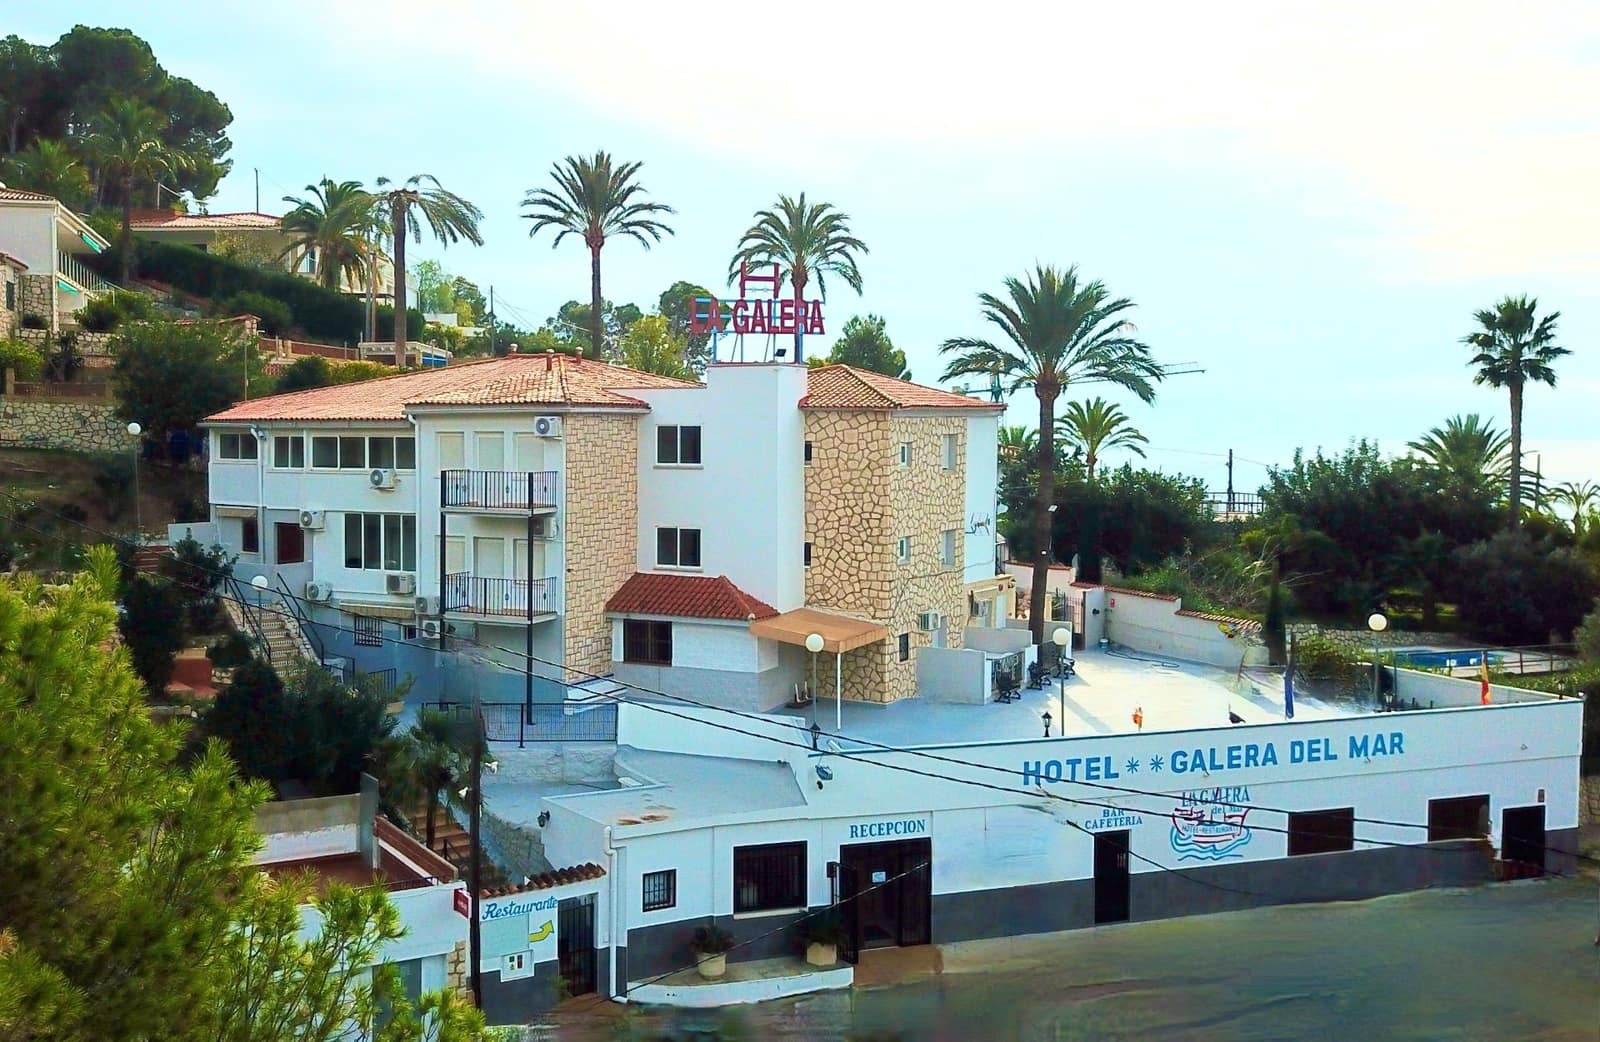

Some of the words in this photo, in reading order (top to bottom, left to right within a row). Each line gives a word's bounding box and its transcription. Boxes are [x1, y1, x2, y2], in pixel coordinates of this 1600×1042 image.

[740, 261, 779, 298] H
[690, 296, 724, 334] LA
[732, 299, 825, 334] GALERA
[1023, 755, 1120, 786] HOTEL
[1170, 742, 1278, 774] GALERA
[1289, 738, 1338, 764] DEL
[1349, 732, 1405, 759] MAR
[1084, 815, 1143, 830] CAFETERIA
[1102, 808, 1125, 818] BAR
[850, 819, 926, 839] RECEPCION
[482, 895, 558, 920] Restaurante
